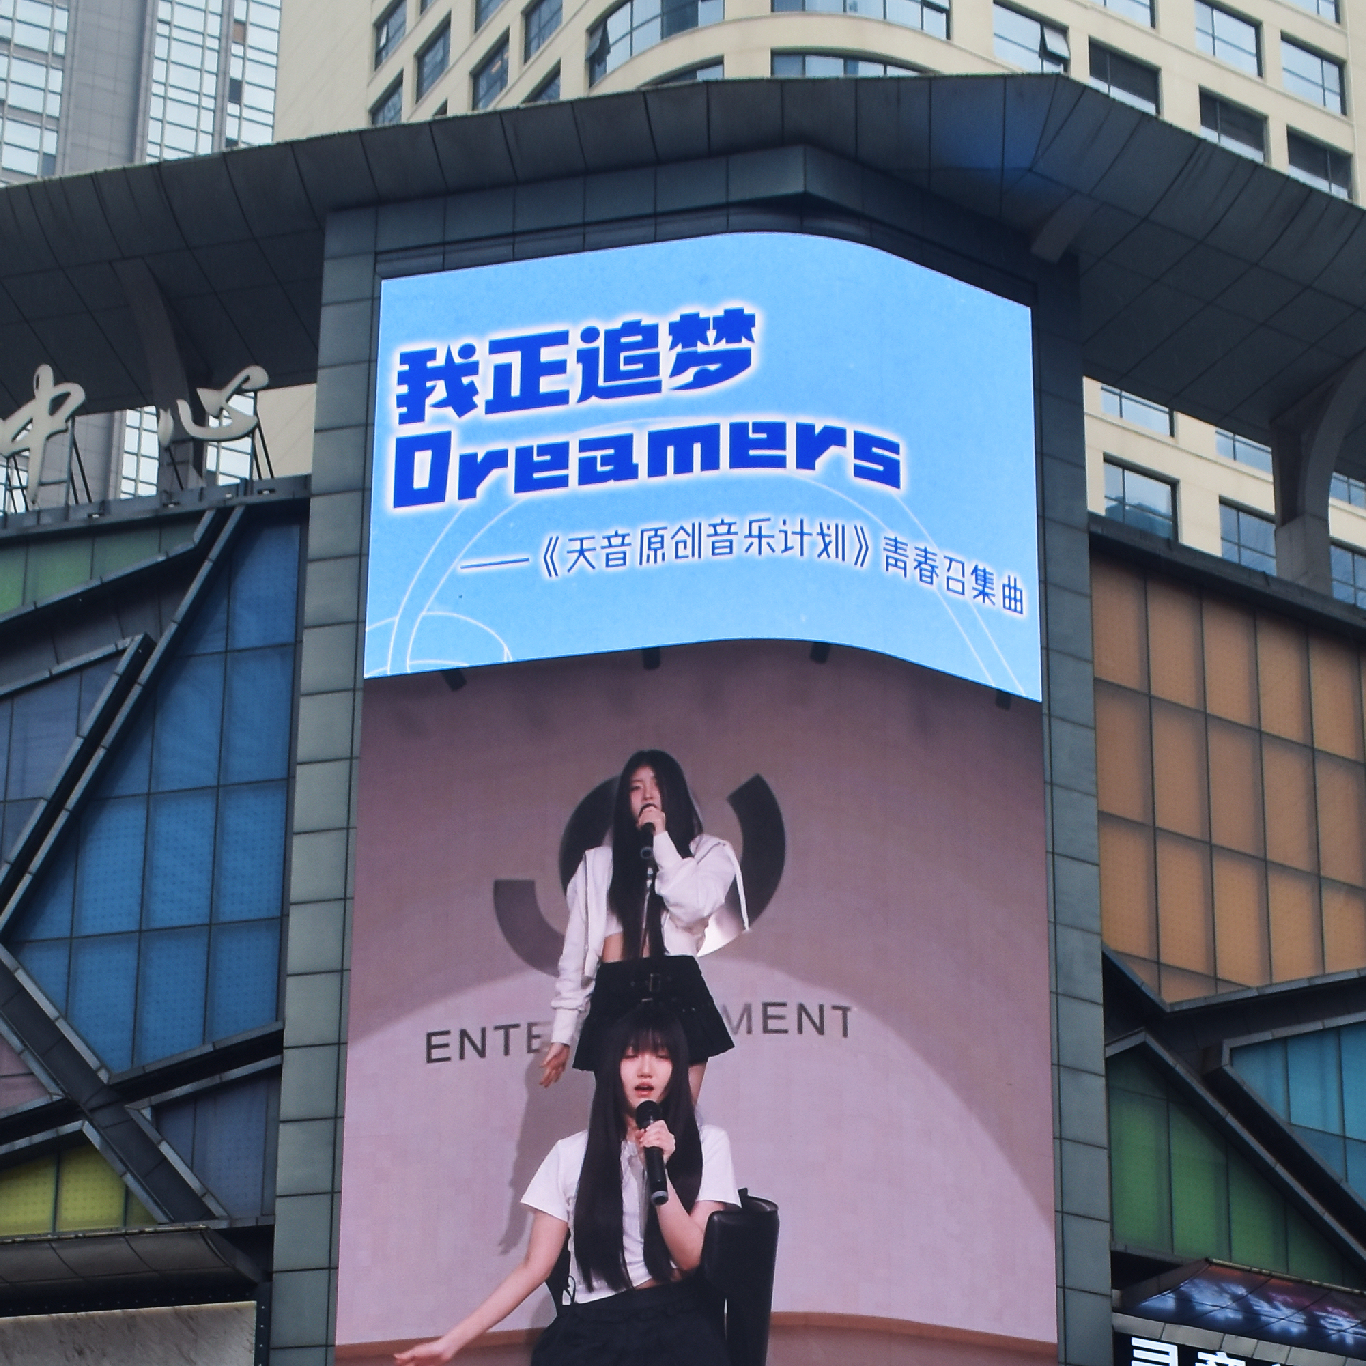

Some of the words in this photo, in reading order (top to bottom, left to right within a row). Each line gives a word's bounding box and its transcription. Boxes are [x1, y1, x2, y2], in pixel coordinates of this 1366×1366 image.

[396, 307, 756, 426] 我正追梦
[392, 420, 902, 509] Dreamers
[425, 1001, 853, 1064] ENTEMENT
